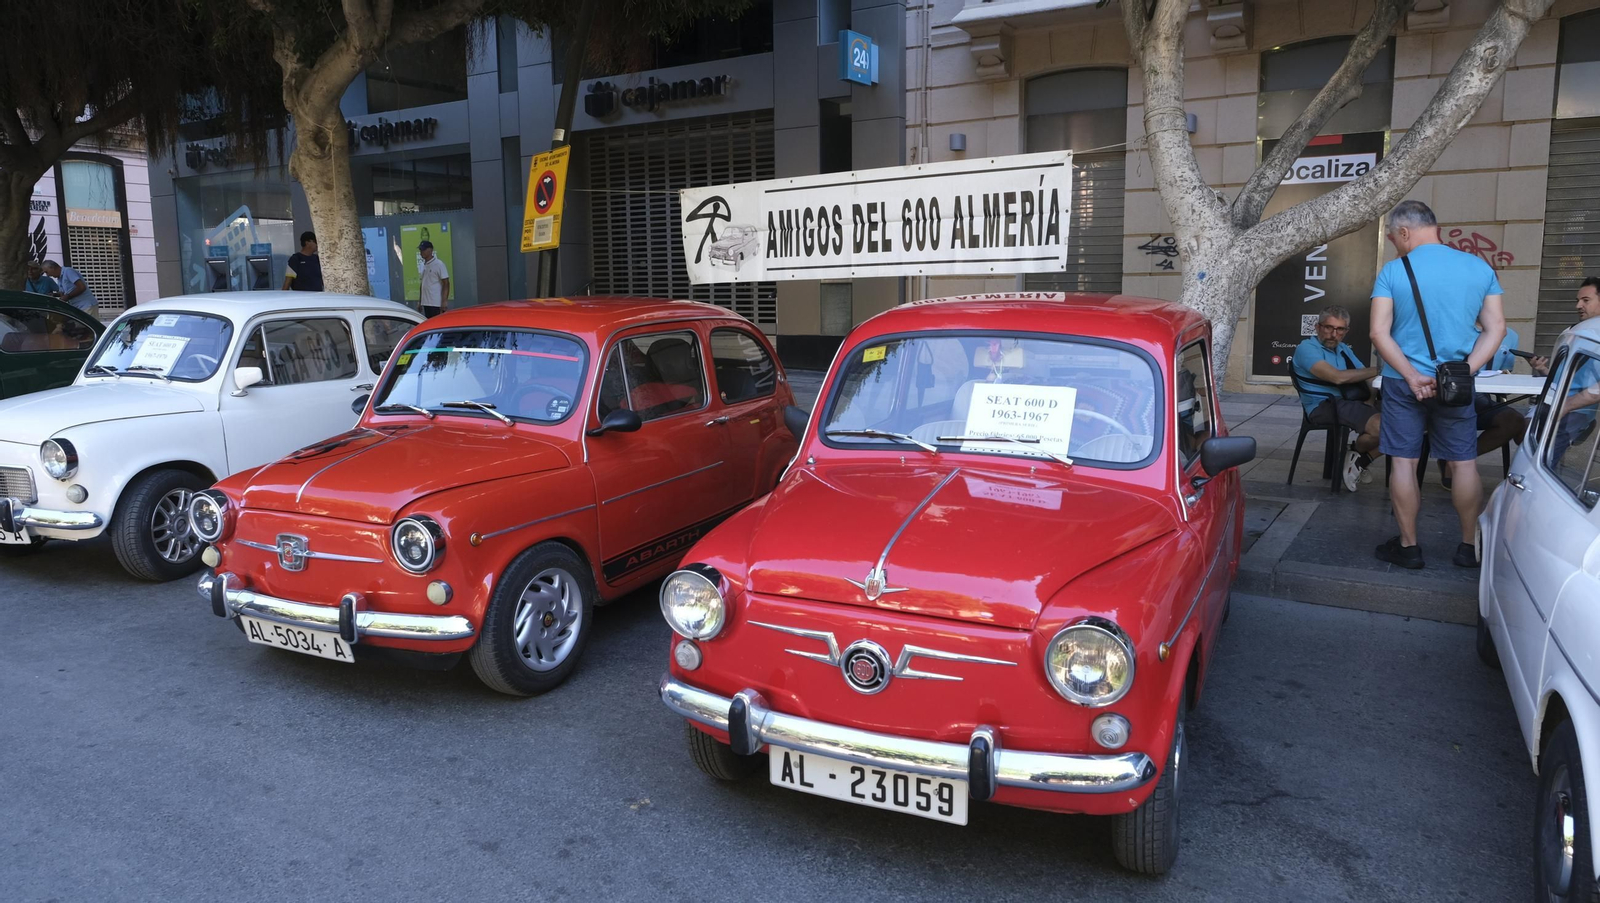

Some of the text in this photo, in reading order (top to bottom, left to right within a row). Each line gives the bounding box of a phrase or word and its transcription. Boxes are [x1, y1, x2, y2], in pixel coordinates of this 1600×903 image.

[621, 74, 731, 111] cajamar
[360, 117, 438, 146] cajamar
[1283, 159, 1370, 181] ocaliza
[765, 174, 1060, 259] AMIGOS DEL 600 ALMERÍA
[1271, 340, 1297, 348] Buscam
[986, 395, 1058, 409] SEAT 600 D
[991, 409, 1049, 422] 1963-1967
[969, 430, 989, 438] Precio
[1040, 435, 1063, 443] Pesetas
[625, 529, 700, 569] ABARTH
[781, 751, 814, 788] AL
[850, 766, 953, 817] 23059
